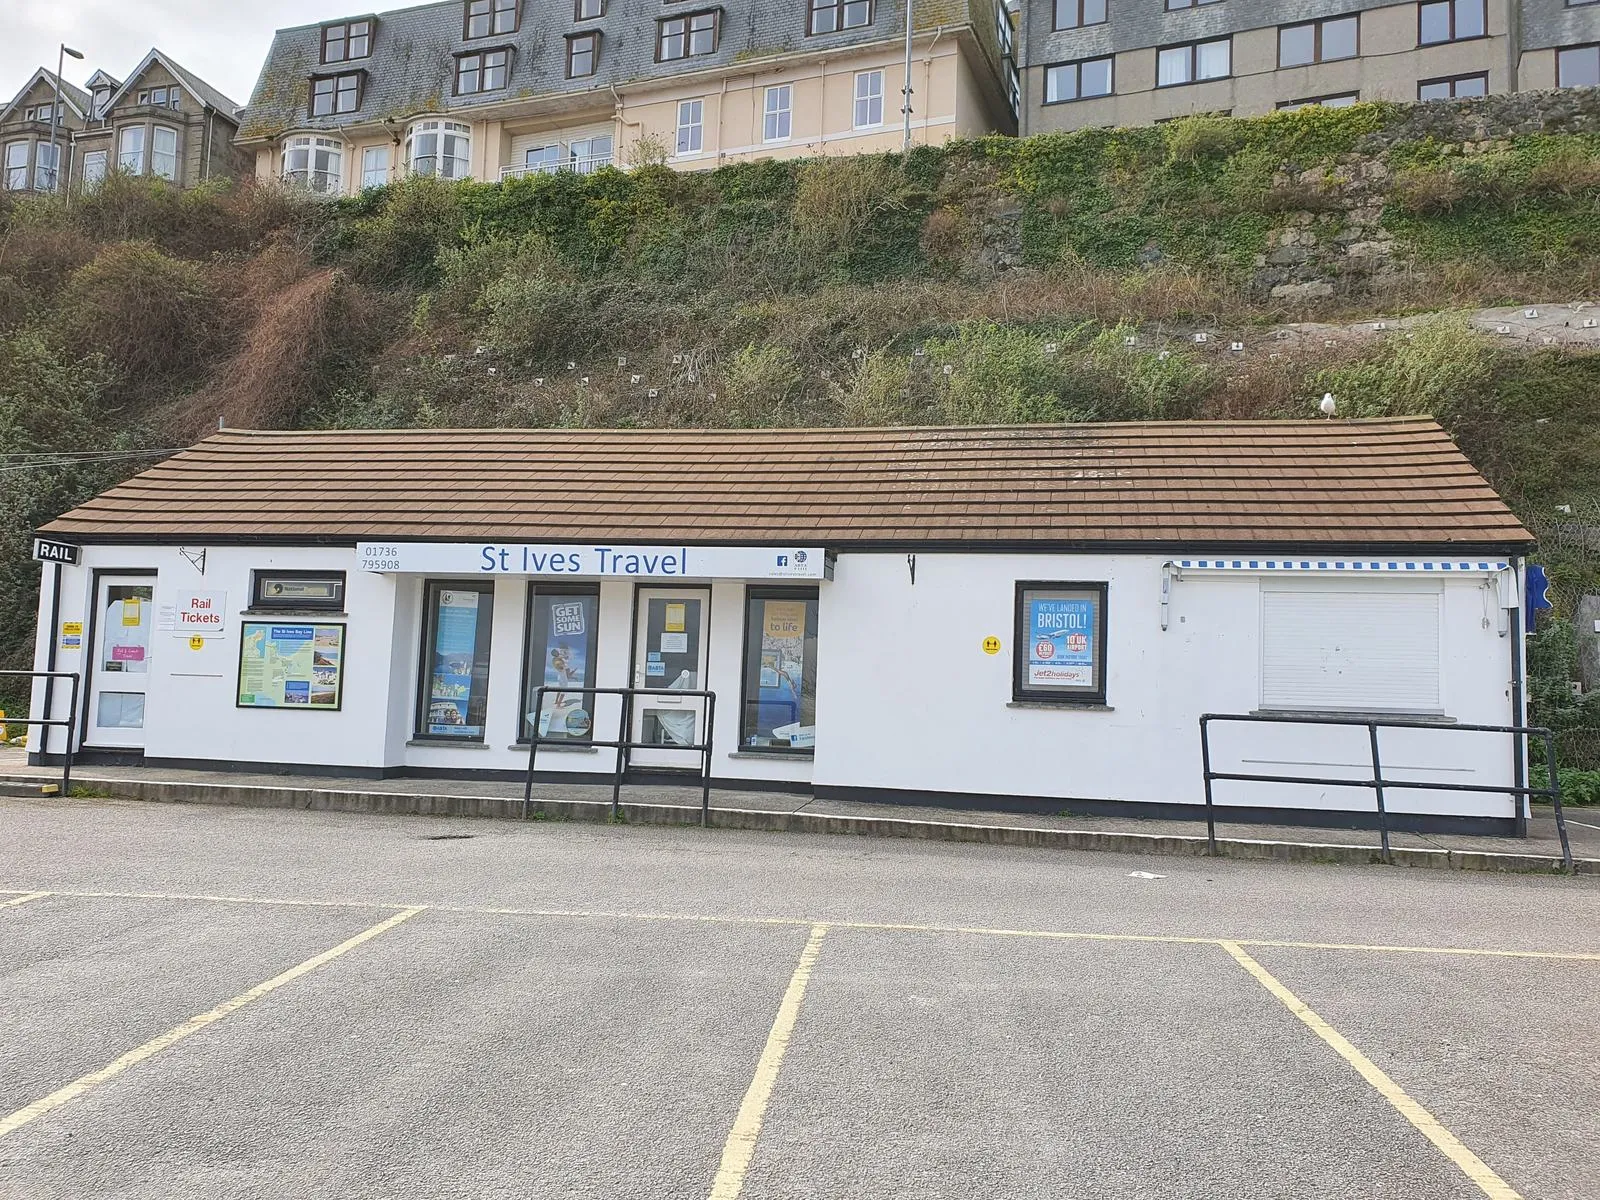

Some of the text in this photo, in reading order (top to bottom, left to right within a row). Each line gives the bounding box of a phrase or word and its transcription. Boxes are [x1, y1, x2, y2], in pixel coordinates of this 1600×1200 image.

[40, 543, 73, 561] RAIL
[365, 546, 398, 557] 01736
[362, 560, 400, 570] 795908
[481, 546, 686, 574] St Ives Travel
[191, 598, 211, 609] Rail
[1056, 603, 1079, 612] LANDED
[1080, 604, 1087, 612] IN
[555, 606, 580, 617] GET
[181, 612, 220, 623] Tickets
[556, 615, 581, 624] SOME
[1038, 613, 1087, 629] BRISTOL!
[557, 622, 581, 633] SUN
[770, 622, 798, 632] to life
[1034, 669, 1080, 679] Jet2holidays
